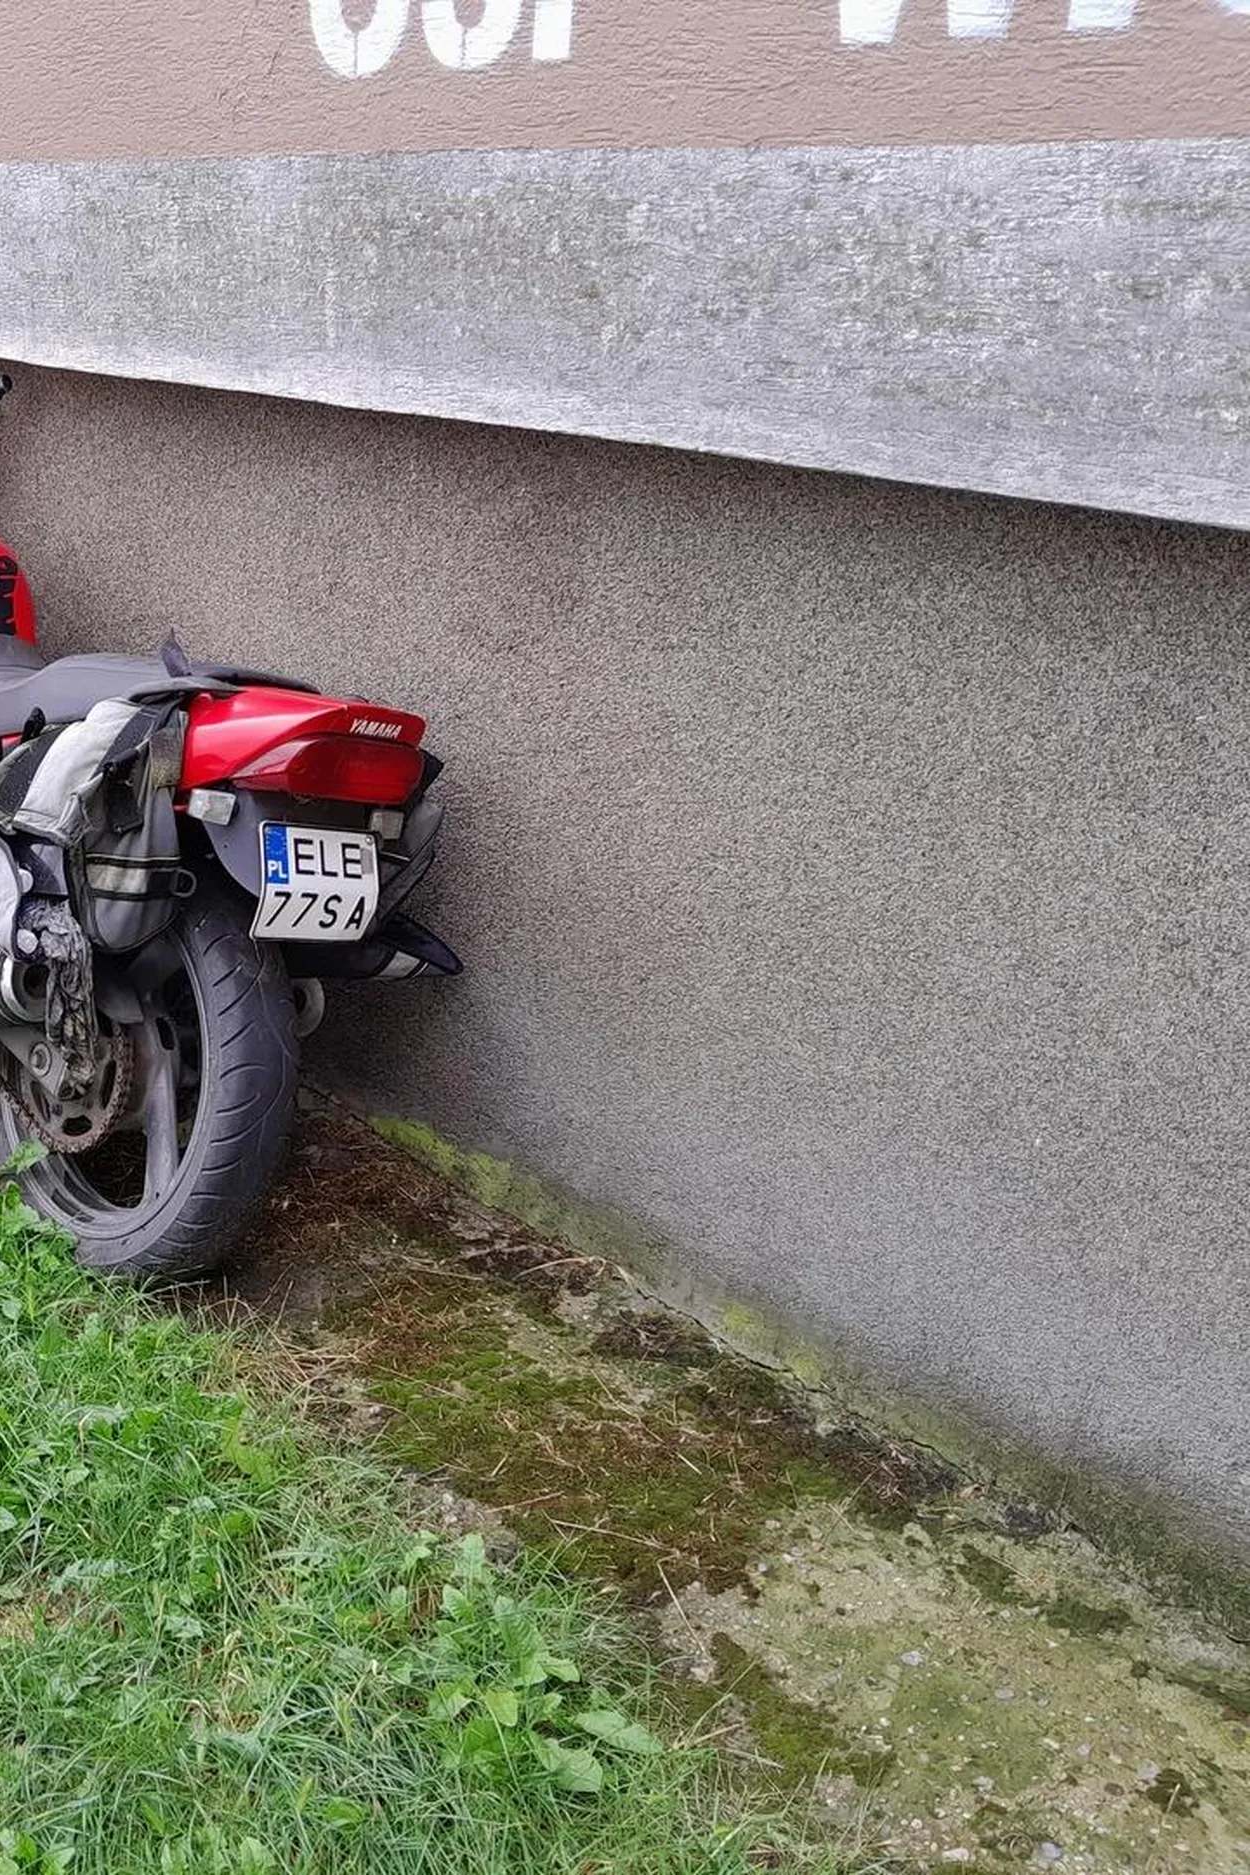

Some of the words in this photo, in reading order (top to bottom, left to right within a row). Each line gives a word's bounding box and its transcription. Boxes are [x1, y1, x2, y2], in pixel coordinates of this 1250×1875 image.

[349, 718, 402, 739] YAMAHA
[267, 860, 287, 878] PL
[293, 838, 362, 879] ELE
[265, 891, 365, 930] 77SA
